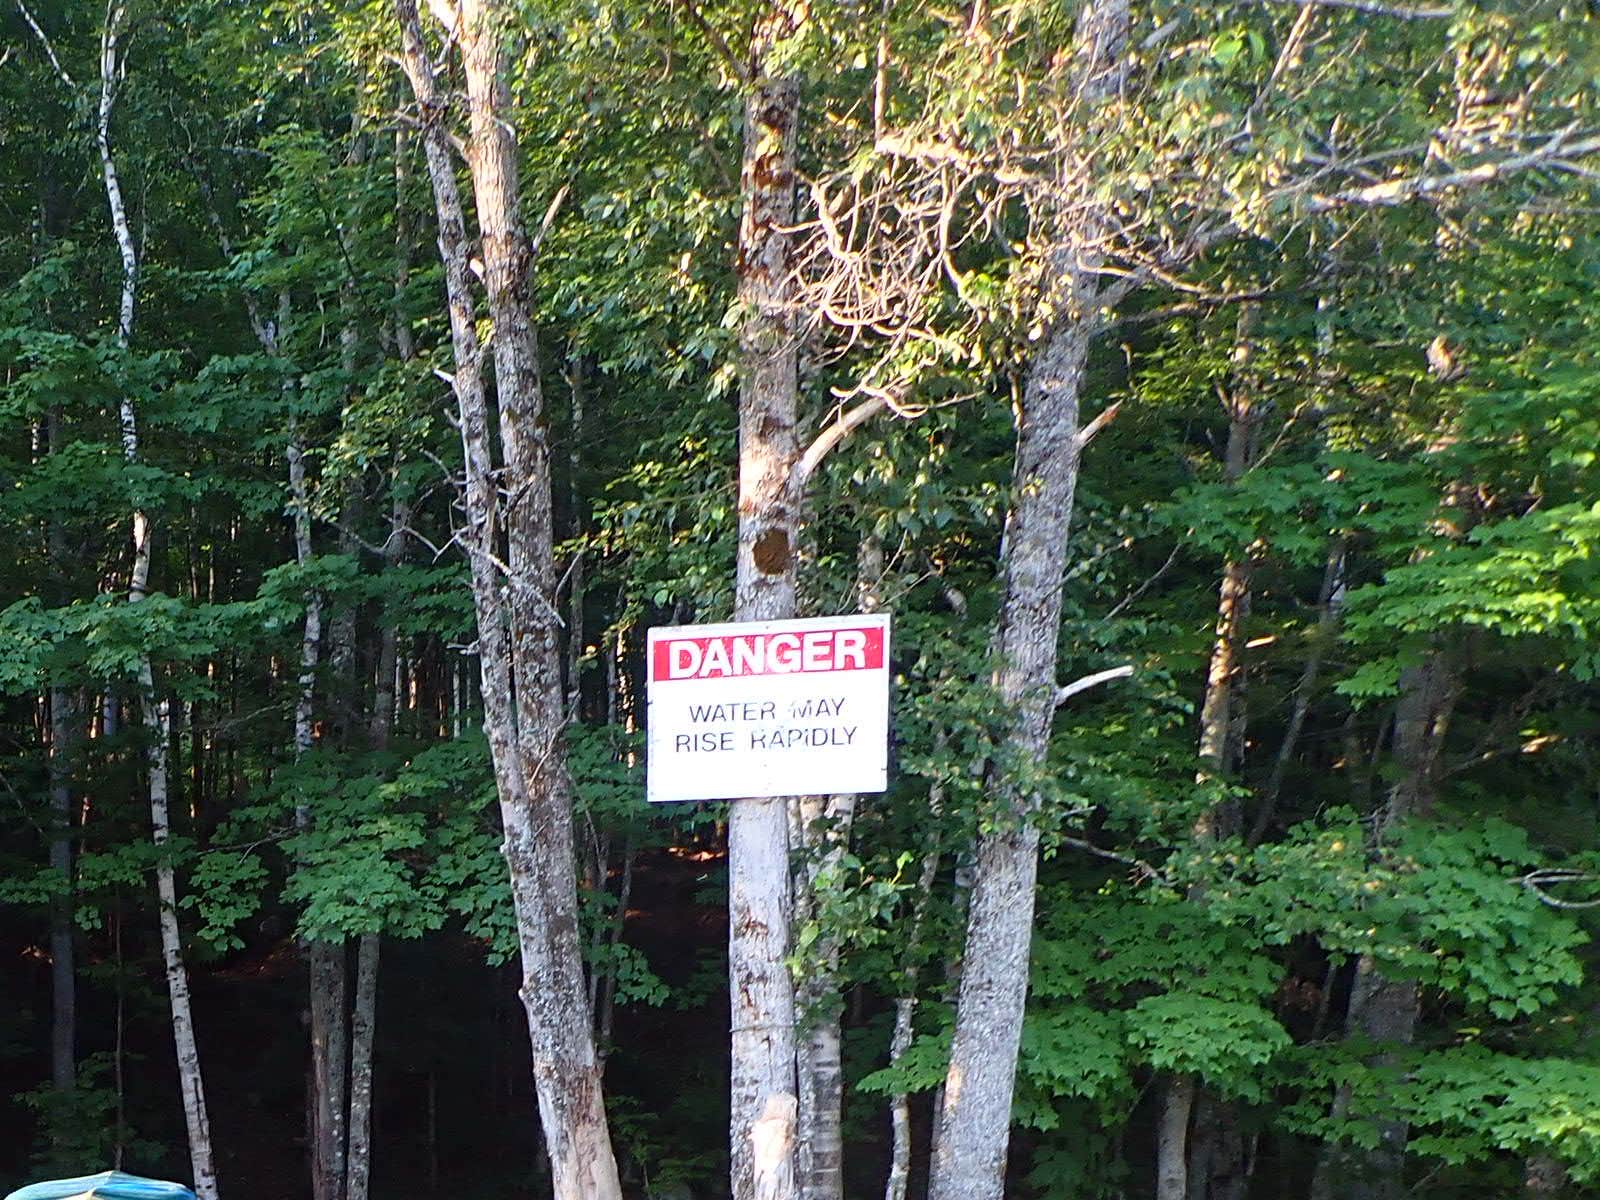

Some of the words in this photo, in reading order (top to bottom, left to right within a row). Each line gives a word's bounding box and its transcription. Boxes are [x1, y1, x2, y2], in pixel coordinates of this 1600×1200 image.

[668, 630, 866, 680] DANGER
[689, 701, 776, 723] WATER
[791, 697, 846, 718] MAY
[675, 732, 735, 753] RISE
[751, 726, 858, 750] RAPIDLY
